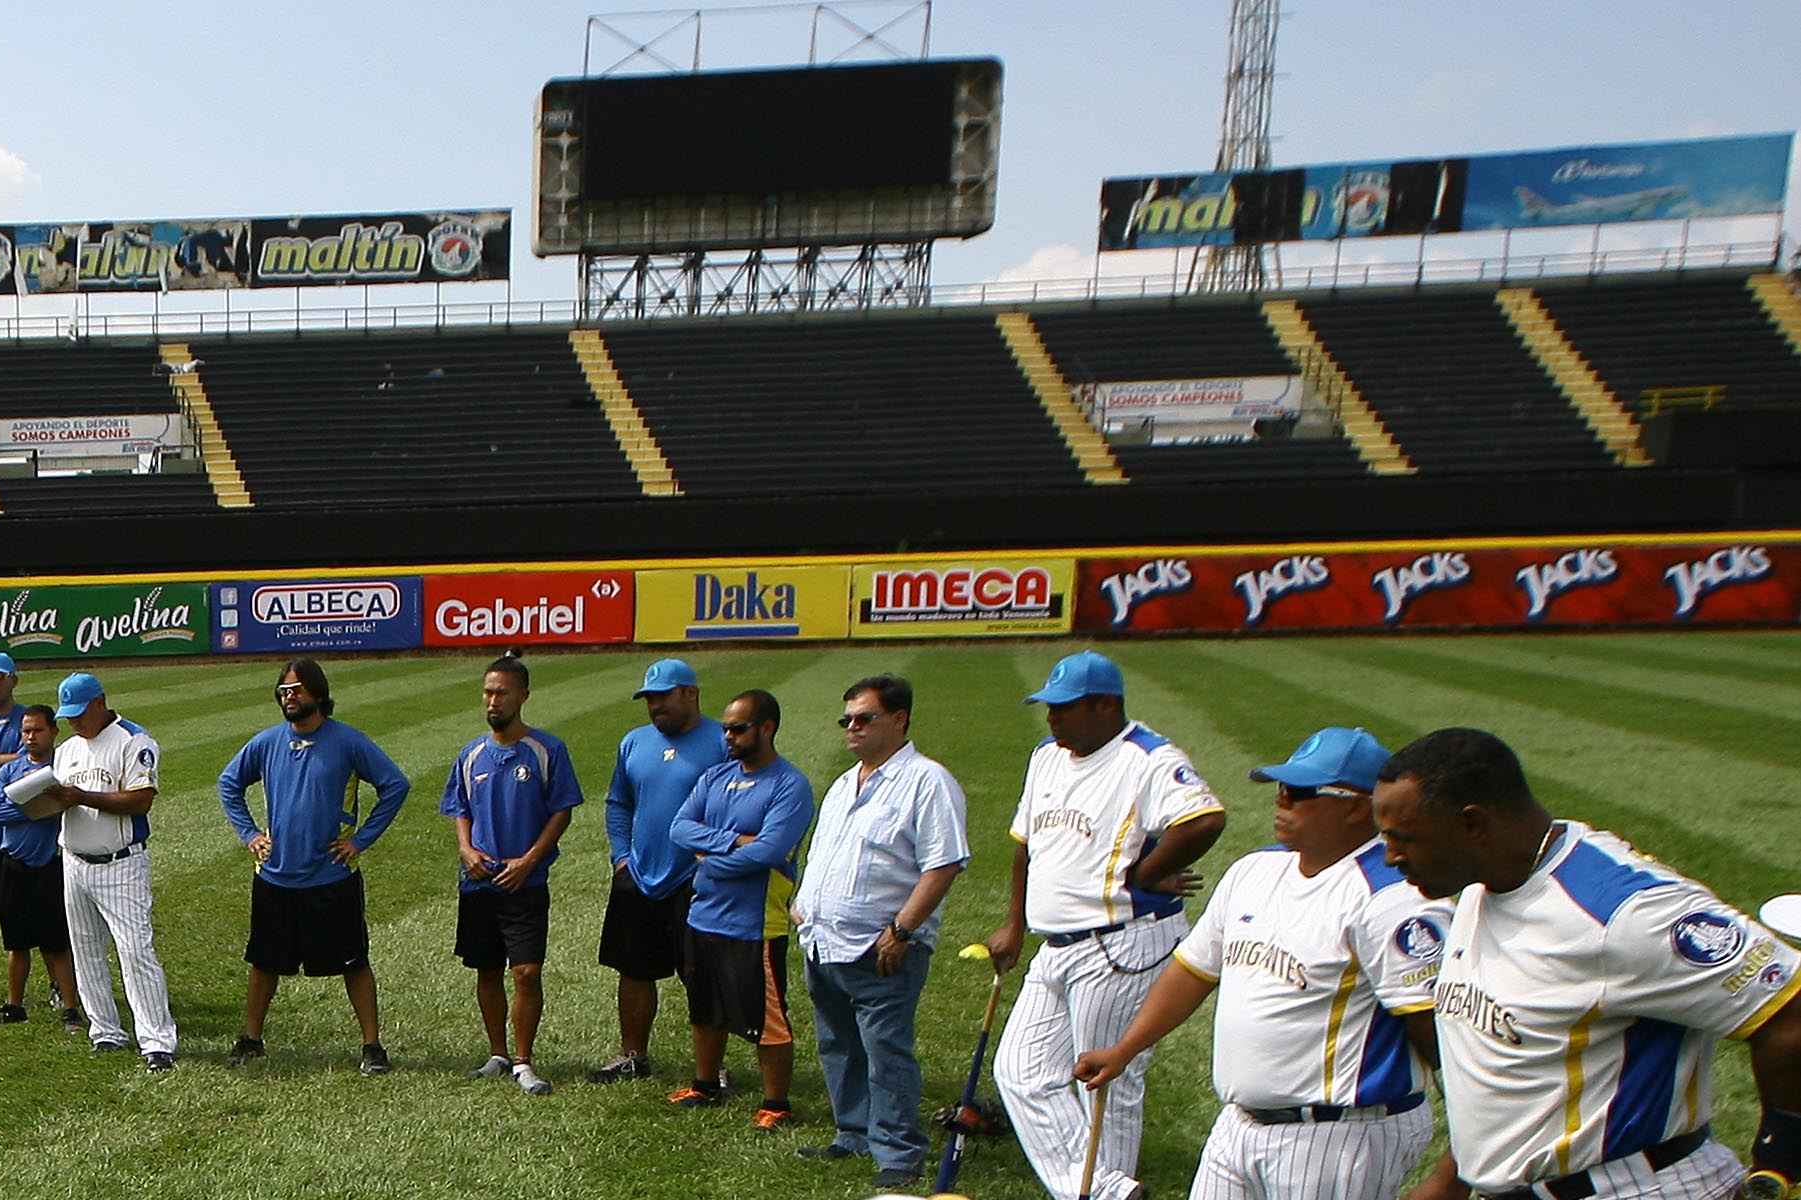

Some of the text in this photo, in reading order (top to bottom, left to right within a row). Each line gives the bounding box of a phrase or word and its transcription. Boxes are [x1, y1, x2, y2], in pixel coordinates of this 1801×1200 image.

[257, 222, 425, 279] maltín
[11, 428, 131, 442] SOMOS CAMPEONES
[13, 419, 130, 431] APOYANDO EL DEPORTE
[265, 590, 389, 621] ALBECA
[694, 572, 795, 621] Daka
[873, 569, 1050, 610] IMECA
[323, 625, 342, 637] que
[435, 596, 584, 637] Gabriel
